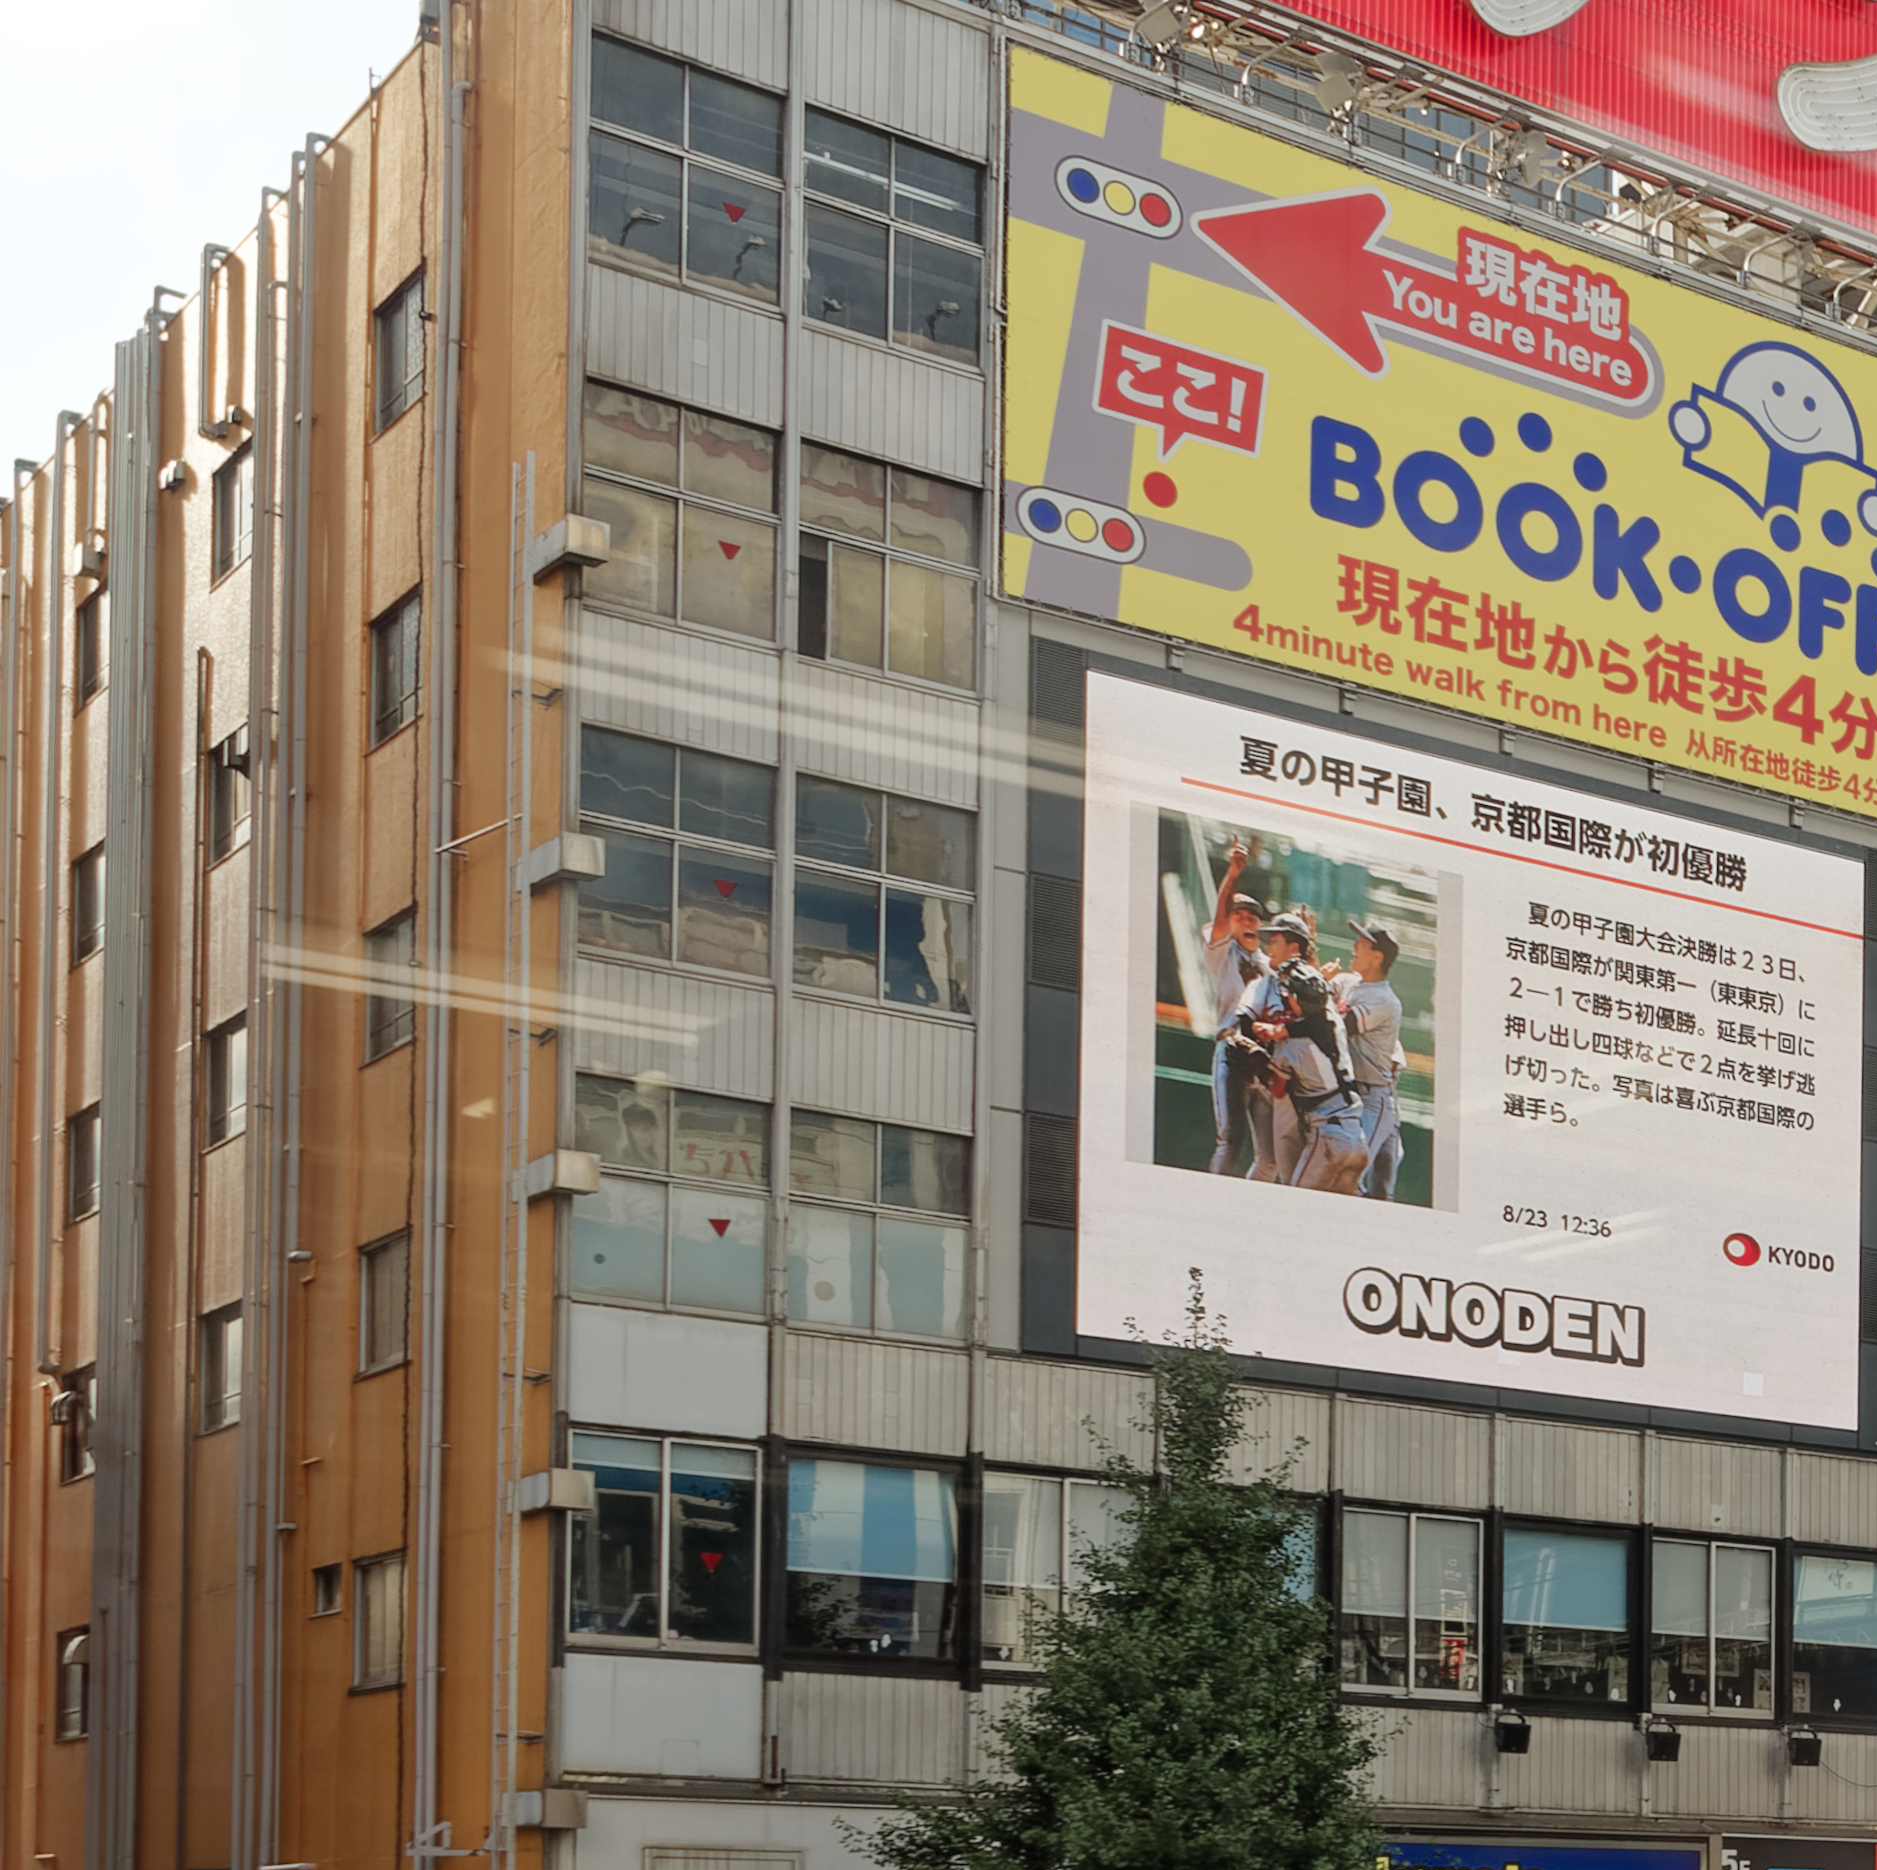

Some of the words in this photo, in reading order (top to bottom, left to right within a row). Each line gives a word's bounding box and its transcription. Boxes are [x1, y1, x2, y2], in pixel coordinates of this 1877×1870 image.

[1382, 271, 1457, 331] You
[1468, 303, 1537, 351] are
[1544, 318, 1633, 387] here
[1464, 236, 1624, 339] 現在地
[1233, 601, 1395, 679] 4minute
[1405, 657, 1484, 704] walk
[1497, 679, 1581, 726] from
[1593, 700, 1666, 747] here
[1240, 736, 1746, 891] 夏の甲子園、京都国際が初優勝
[1504, 1093, 1580, 1127] 選手ら。
[1502, 1206, 1547, 1229] 8/23
[1560, 1213, 1612, 1239] 12:36
[1769, 1245, 1835, 1272] KYODO
[1343, 1267, 1645, 1368] ONODEN
